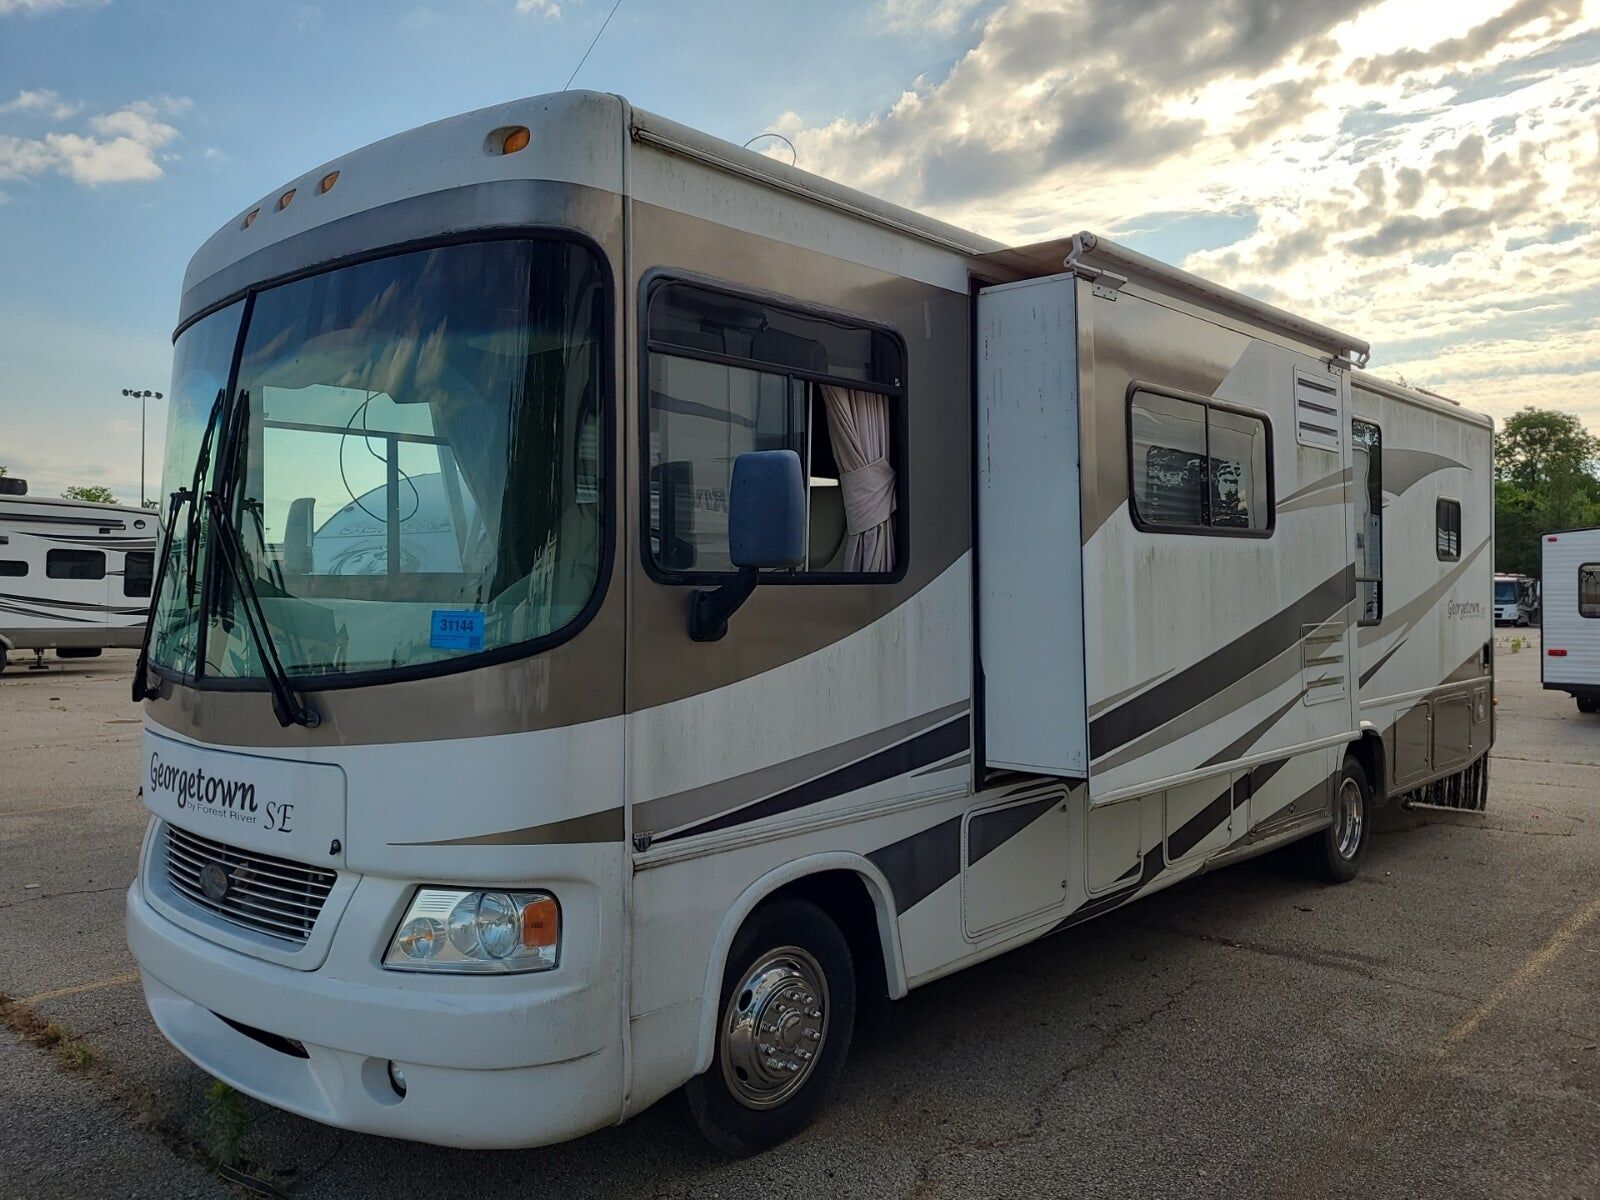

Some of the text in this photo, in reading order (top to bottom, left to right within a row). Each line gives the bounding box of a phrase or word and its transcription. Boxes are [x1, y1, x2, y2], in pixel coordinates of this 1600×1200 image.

[440, 618, 474, 632] 31144
[150, 751, 295, 834] Georgetown SE
[187, 800, 258, 825] by Forest River
